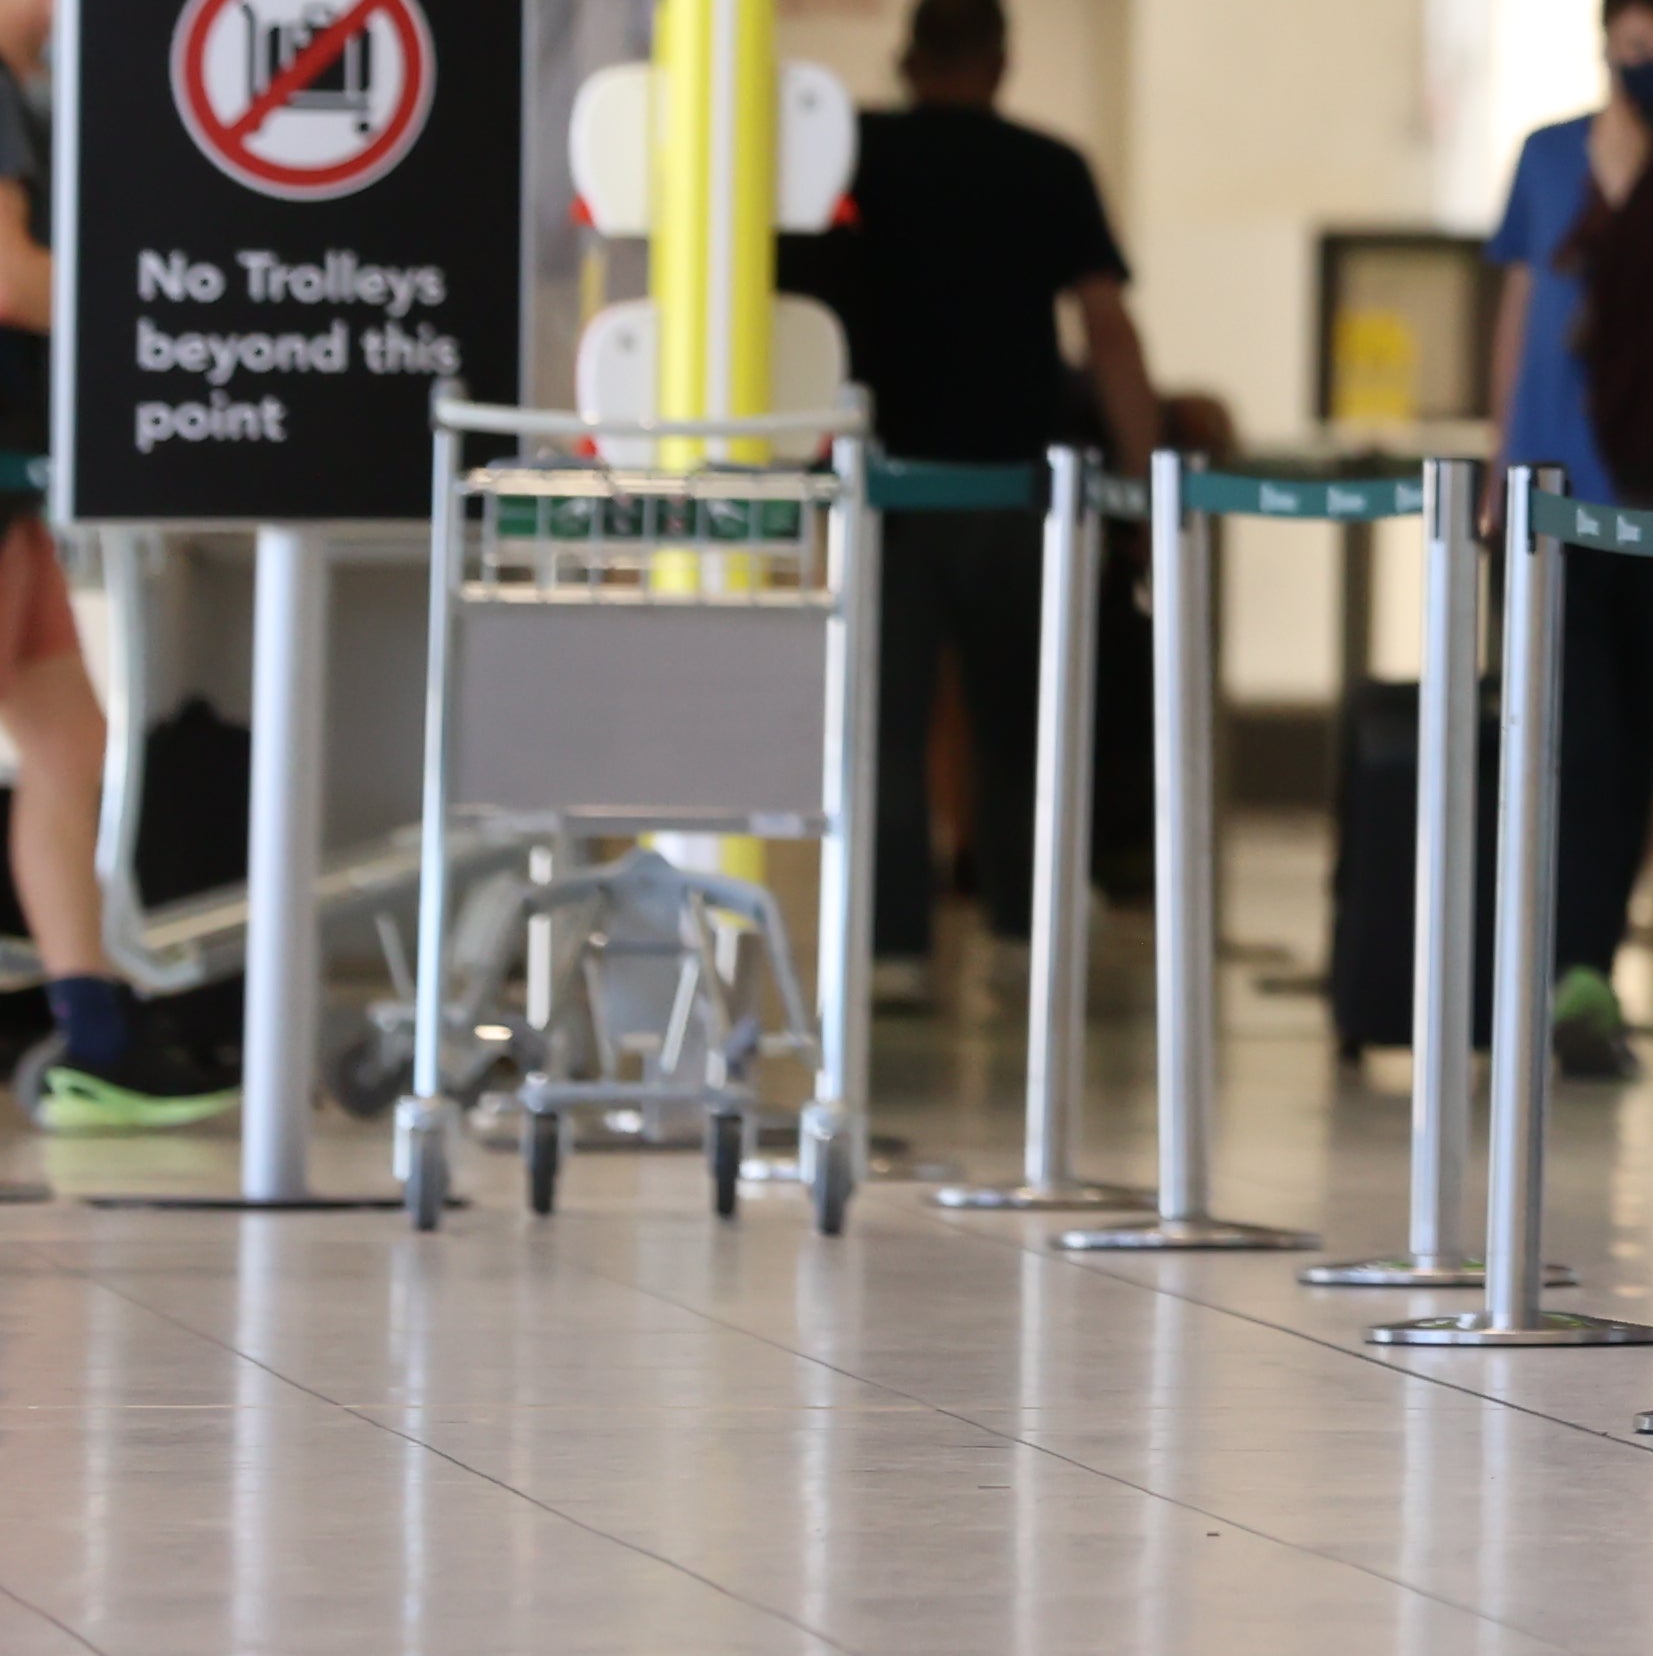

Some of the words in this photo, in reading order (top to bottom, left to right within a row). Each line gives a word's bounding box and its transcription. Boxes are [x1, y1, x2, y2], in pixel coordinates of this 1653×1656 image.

[137, 248, 226, 303] No
[236, 249, 446, 318] Trolleys
[136, 316, 349, 386] beyond
[361, 318, 462, 376] this
[135, 387, 288, 454] point
